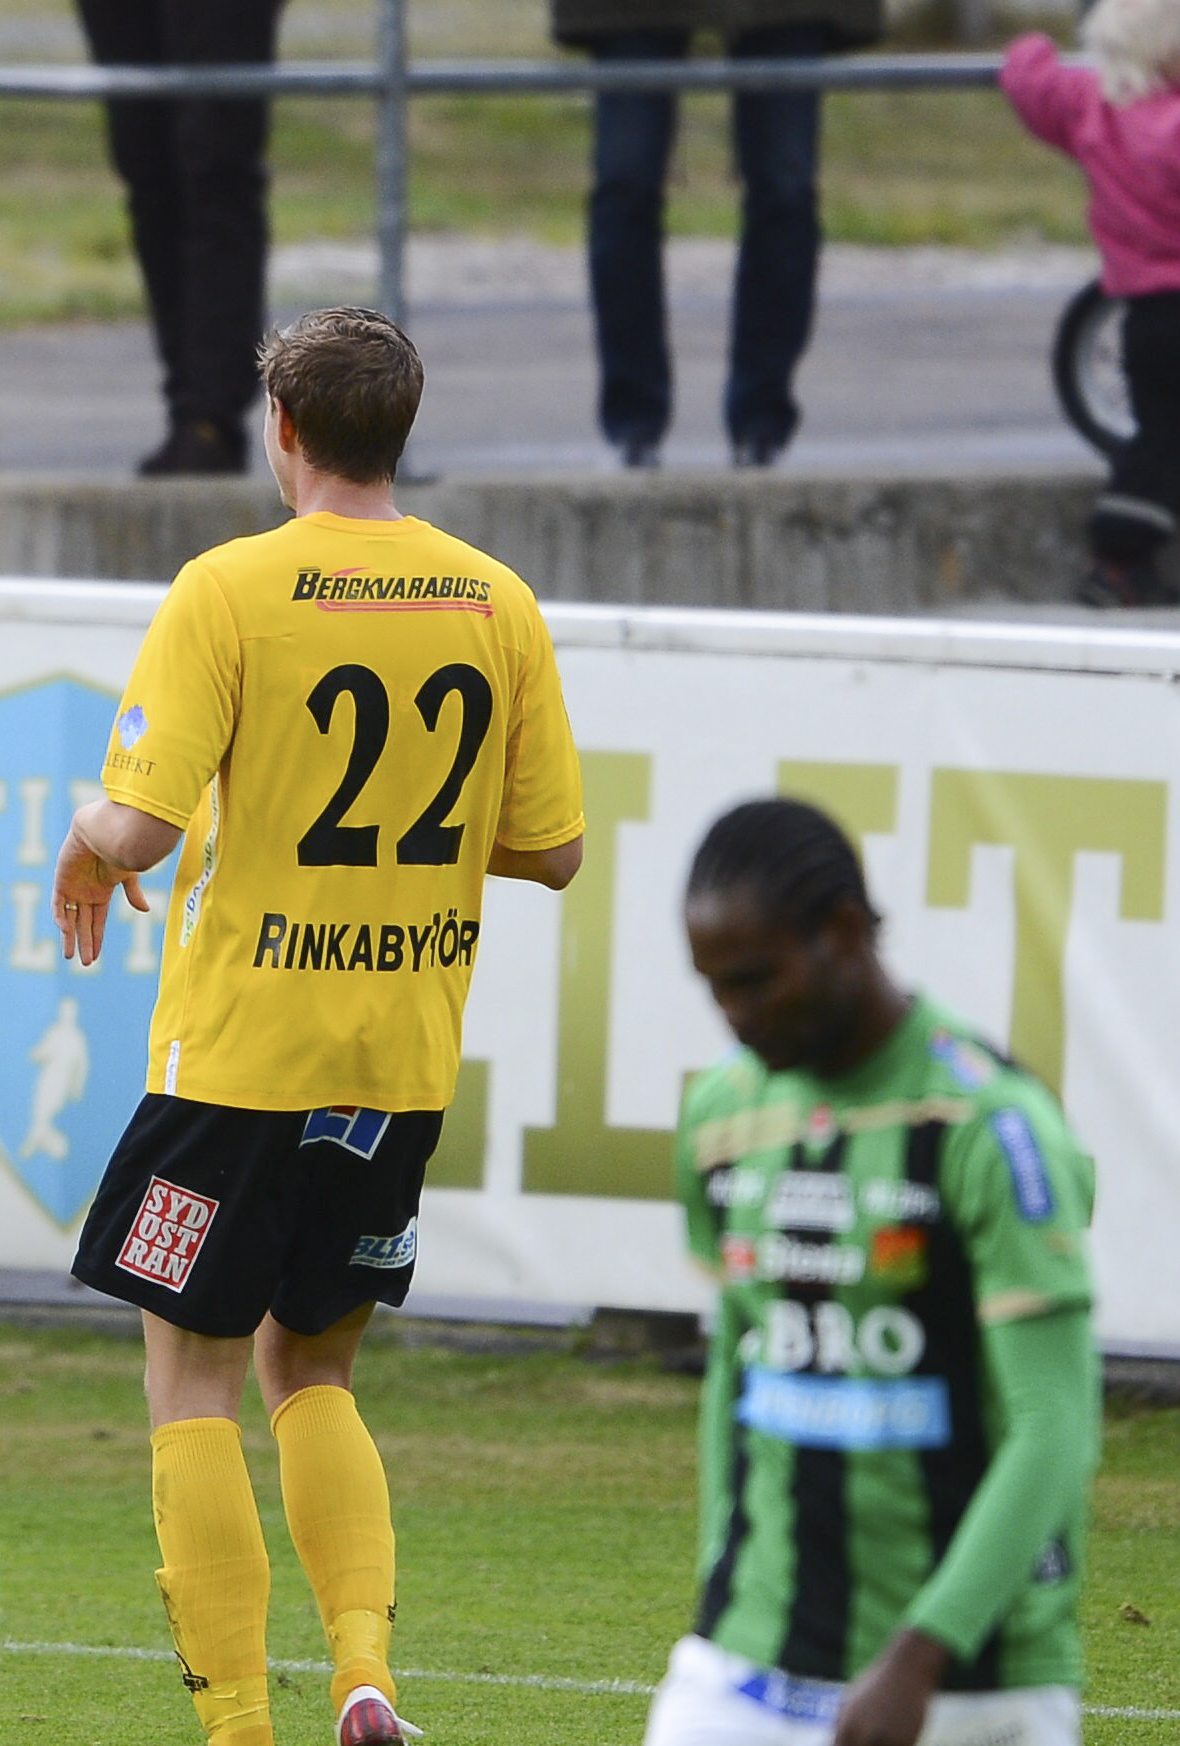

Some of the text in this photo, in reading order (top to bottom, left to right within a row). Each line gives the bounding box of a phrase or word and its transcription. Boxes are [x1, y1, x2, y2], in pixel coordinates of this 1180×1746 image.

[291, 567, 491, 602] BERGKVARABUSS
[297, 663, 494, 868] 22
[145, 1184, 209, 1230] SYD
[123, 1236, 190, 1283] RAN
